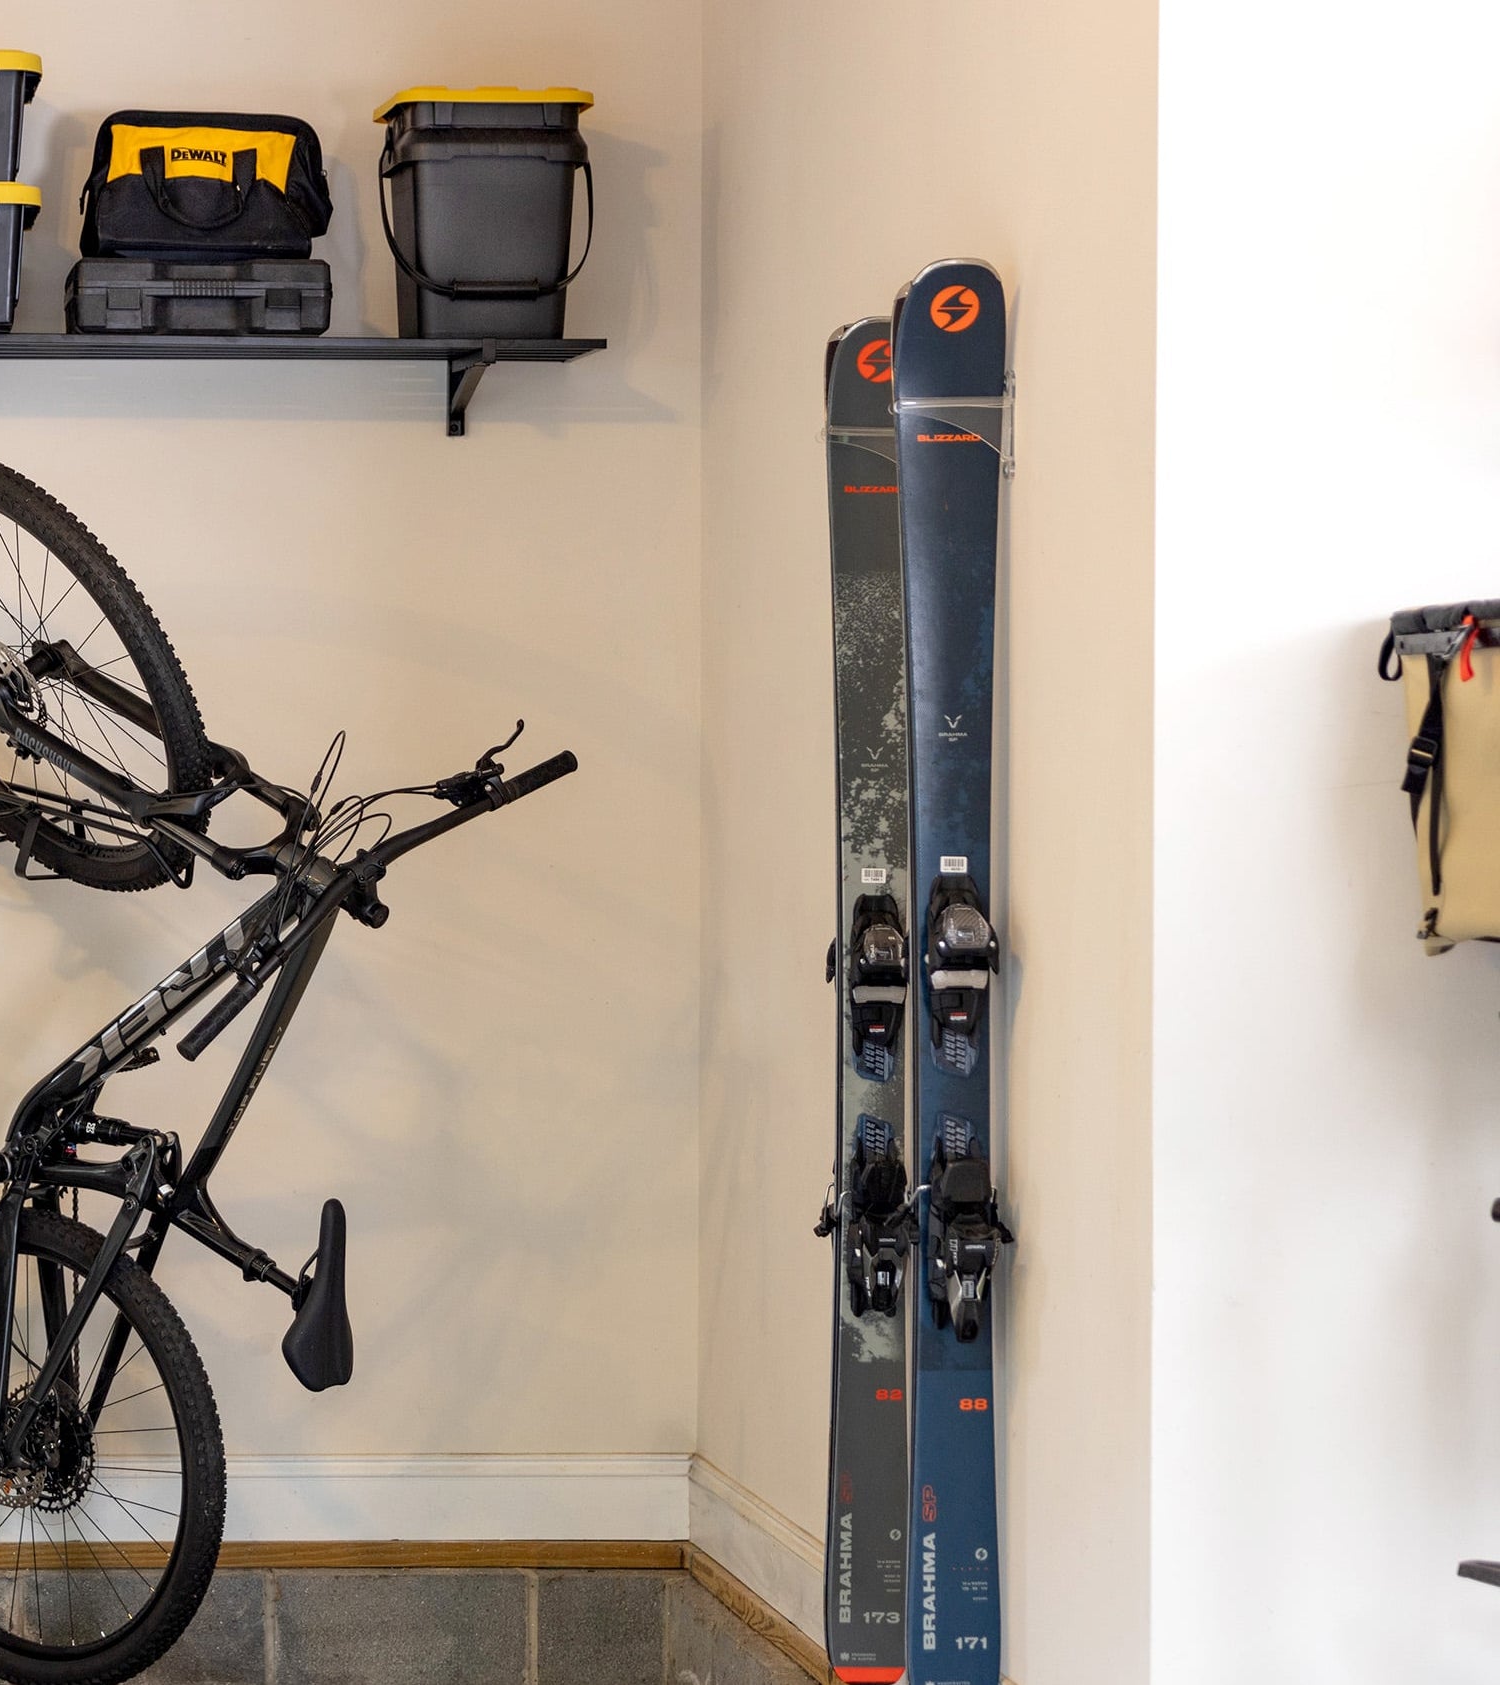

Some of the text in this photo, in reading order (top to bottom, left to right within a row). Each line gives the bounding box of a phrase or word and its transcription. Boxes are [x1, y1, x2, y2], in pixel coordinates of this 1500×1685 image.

[171, 148, 227, 166] DEWALT
[916, 434, 981, 443] BLIZZARD
[844, 485, 899, 494] BLIZZAR
[875, 1388, 903, 1401] 82
[958, 1398, 989, 1411] 88
[839, 1512, 853, 1624] BRAHMA
[922, 1484, 937, 1651] BRAHMA SP
[863, 1611, 901, 1624] 173
[955, 1636, 988, 1650] 171
